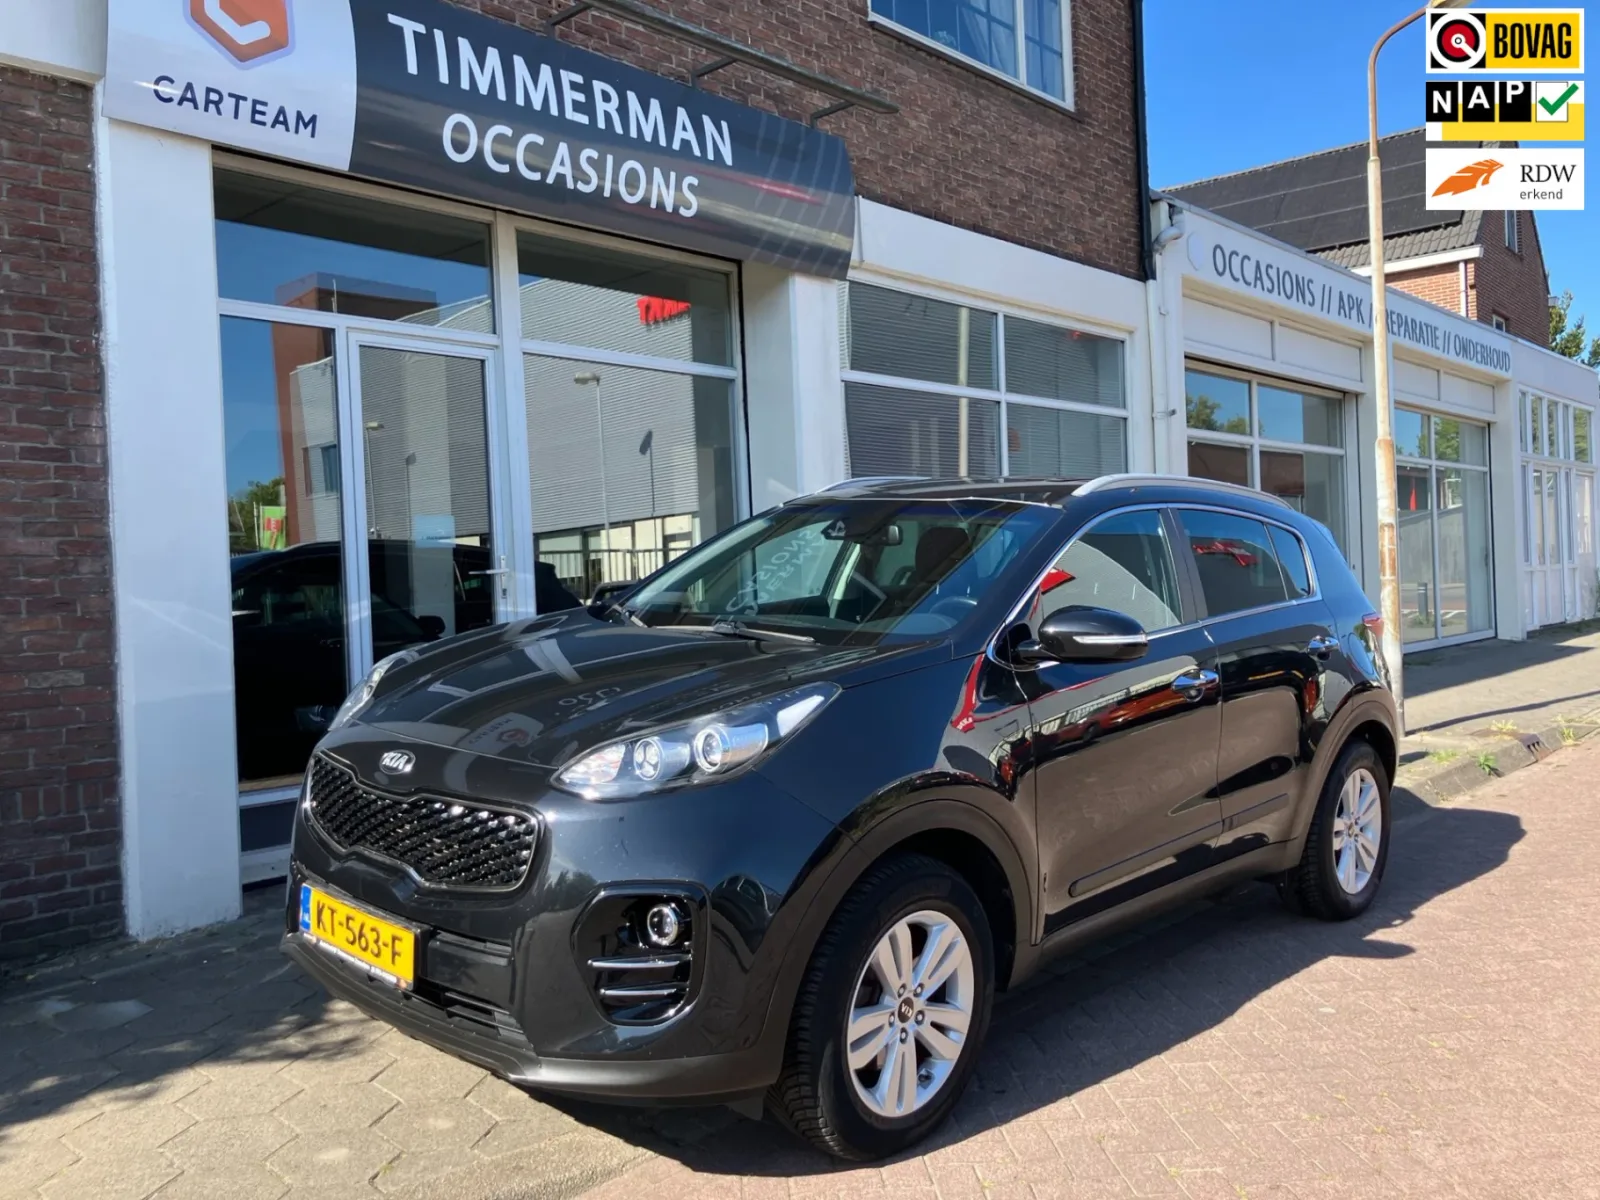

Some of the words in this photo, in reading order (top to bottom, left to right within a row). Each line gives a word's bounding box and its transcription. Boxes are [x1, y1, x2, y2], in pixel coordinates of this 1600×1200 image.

[152, 75, 318, 139] CARTEAM
[386, 13, 733, 167] TIMMERMAN
[442, 113, 700, 218] OCCASIONS
[1212, 244, 1316, 308] OCCASIONS
[1337, 290, 1365, 325] APK
[1453, 333, 1511, 373] ONDERHOUD
[381, 751, 409, 770] KIA
[316, 899, 403, 967] KT-563-F
